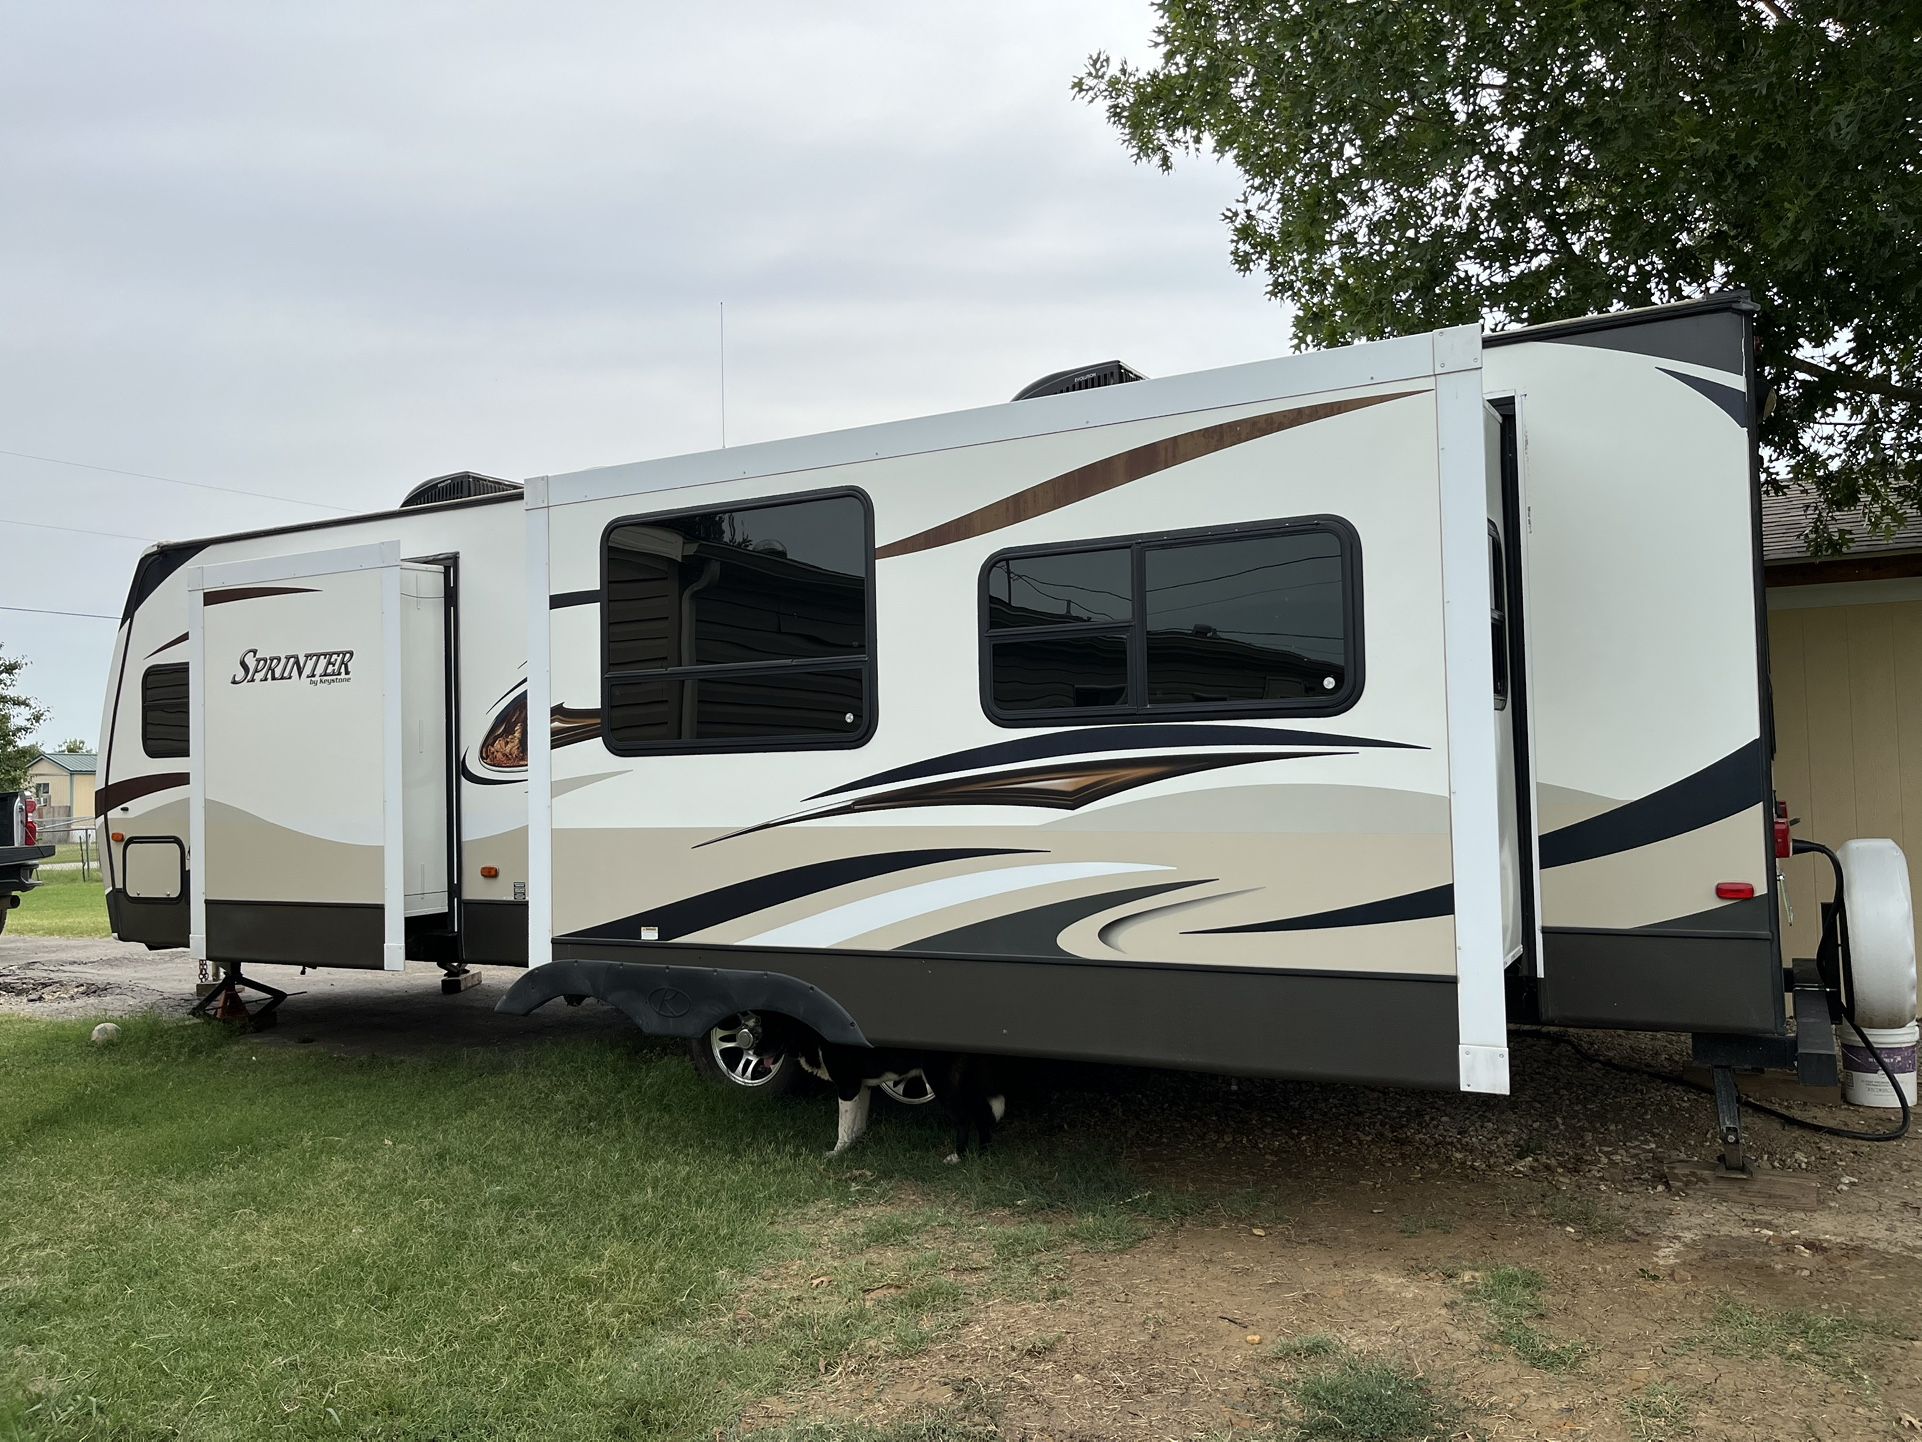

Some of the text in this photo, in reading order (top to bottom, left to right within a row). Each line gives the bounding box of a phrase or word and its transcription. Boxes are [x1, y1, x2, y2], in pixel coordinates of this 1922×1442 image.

[230, 648, 354, 685] SPRINTER
[310, 677, 352, 686] by Keystone
